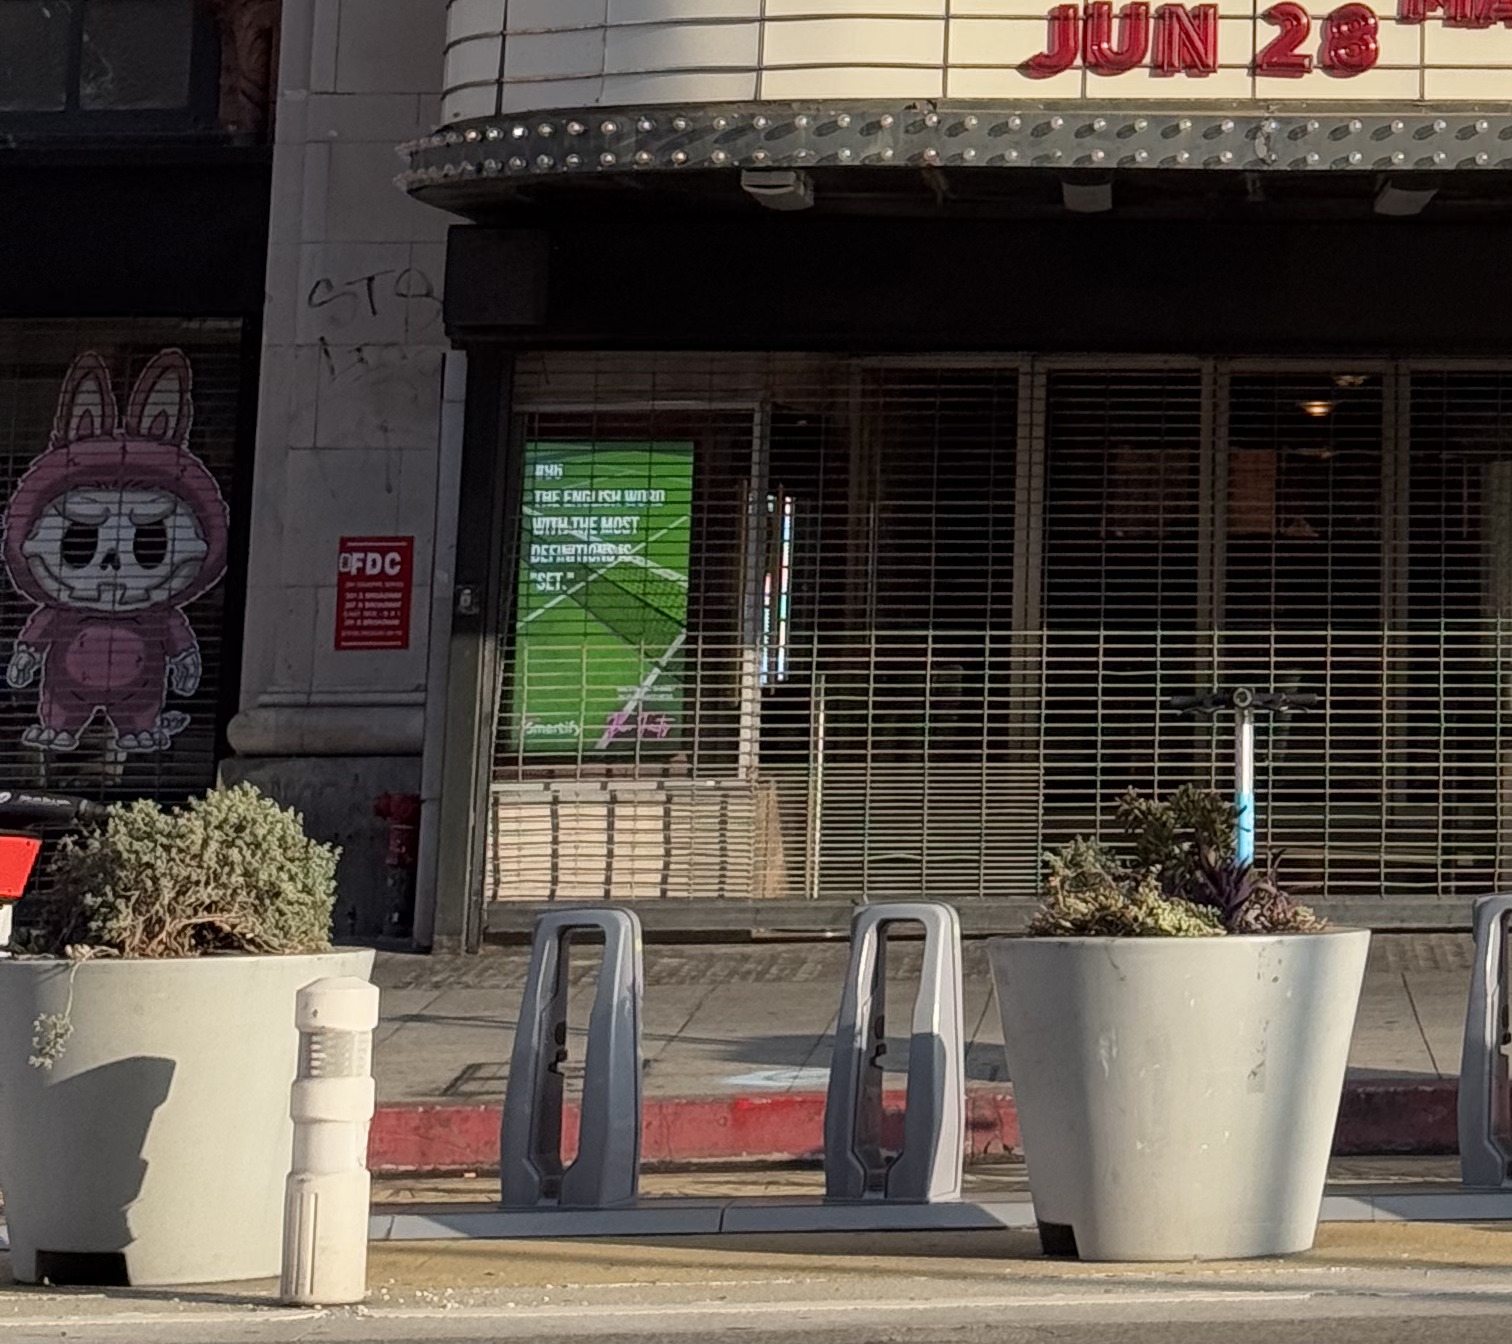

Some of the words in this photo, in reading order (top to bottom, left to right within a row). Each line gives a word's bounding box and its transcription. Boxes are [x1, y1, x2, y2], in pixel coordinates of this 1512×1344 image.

[1018, 1, 1221, 79] JUN
[1252, 2, 1381, 79] 28
[534, 489, 561, 507] THE
[563, 489, 622, 508] ENGLISH
[624, 489, 667, 508] WORD
[532, 516, 569, 535] WITH
[570, 516, 599, 535] THE
[601, 516, 640, 535] MOST
[530, 543, 616, 563] DEFINITIONS
